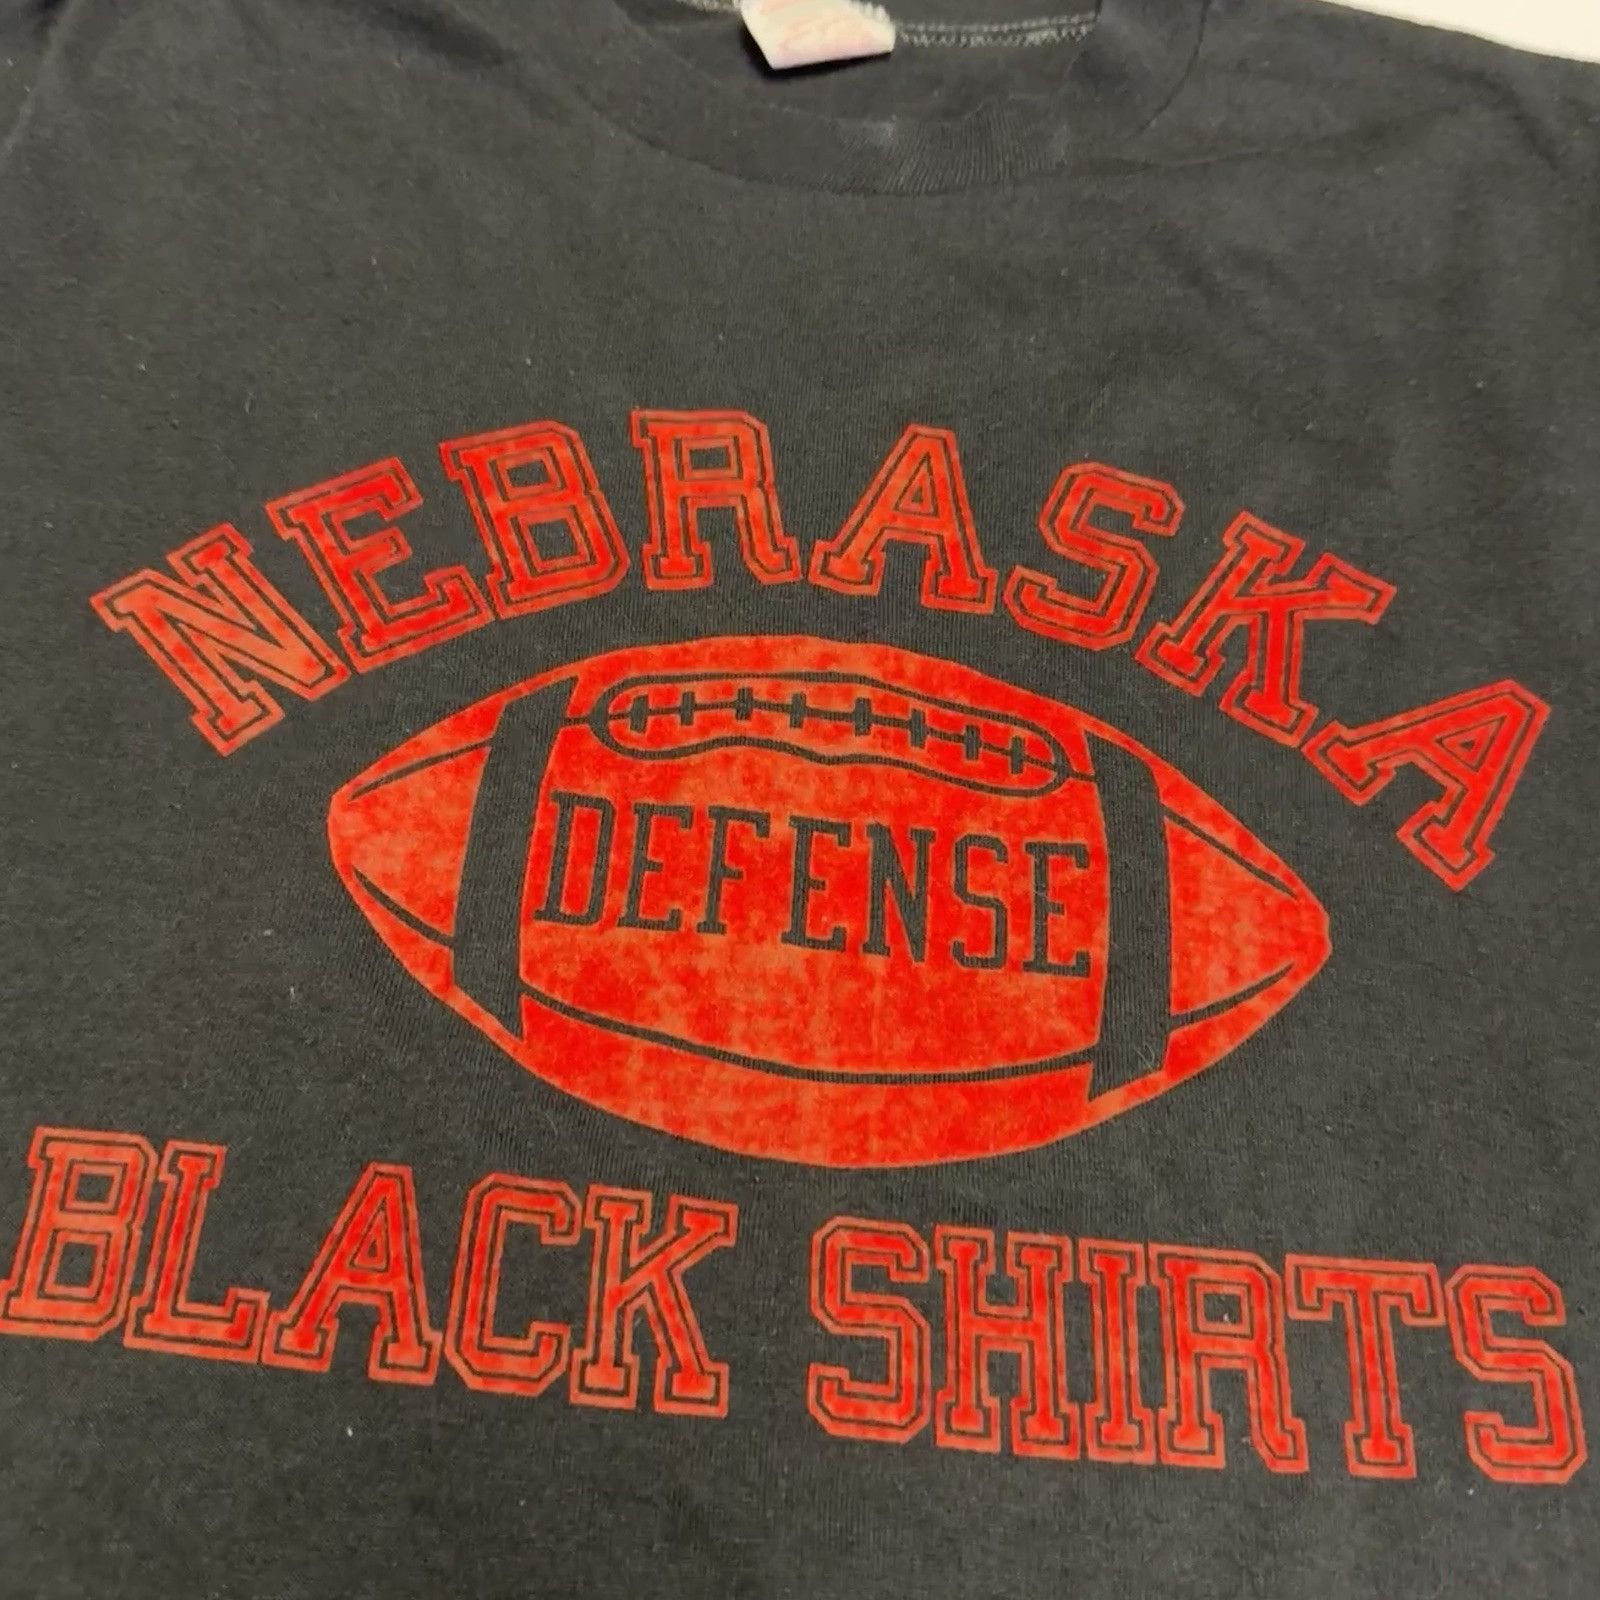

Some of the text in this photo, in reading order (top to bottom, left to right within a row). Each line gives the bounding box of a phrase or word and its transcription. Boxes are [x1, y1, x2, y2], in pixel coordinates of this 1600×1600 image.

[89, 408, 1552, 892] NEBRASKA
[533, 790, 1092, 978] DEFENSE
[0, 1125, 1588, 1485] BLACK SHIRTS
